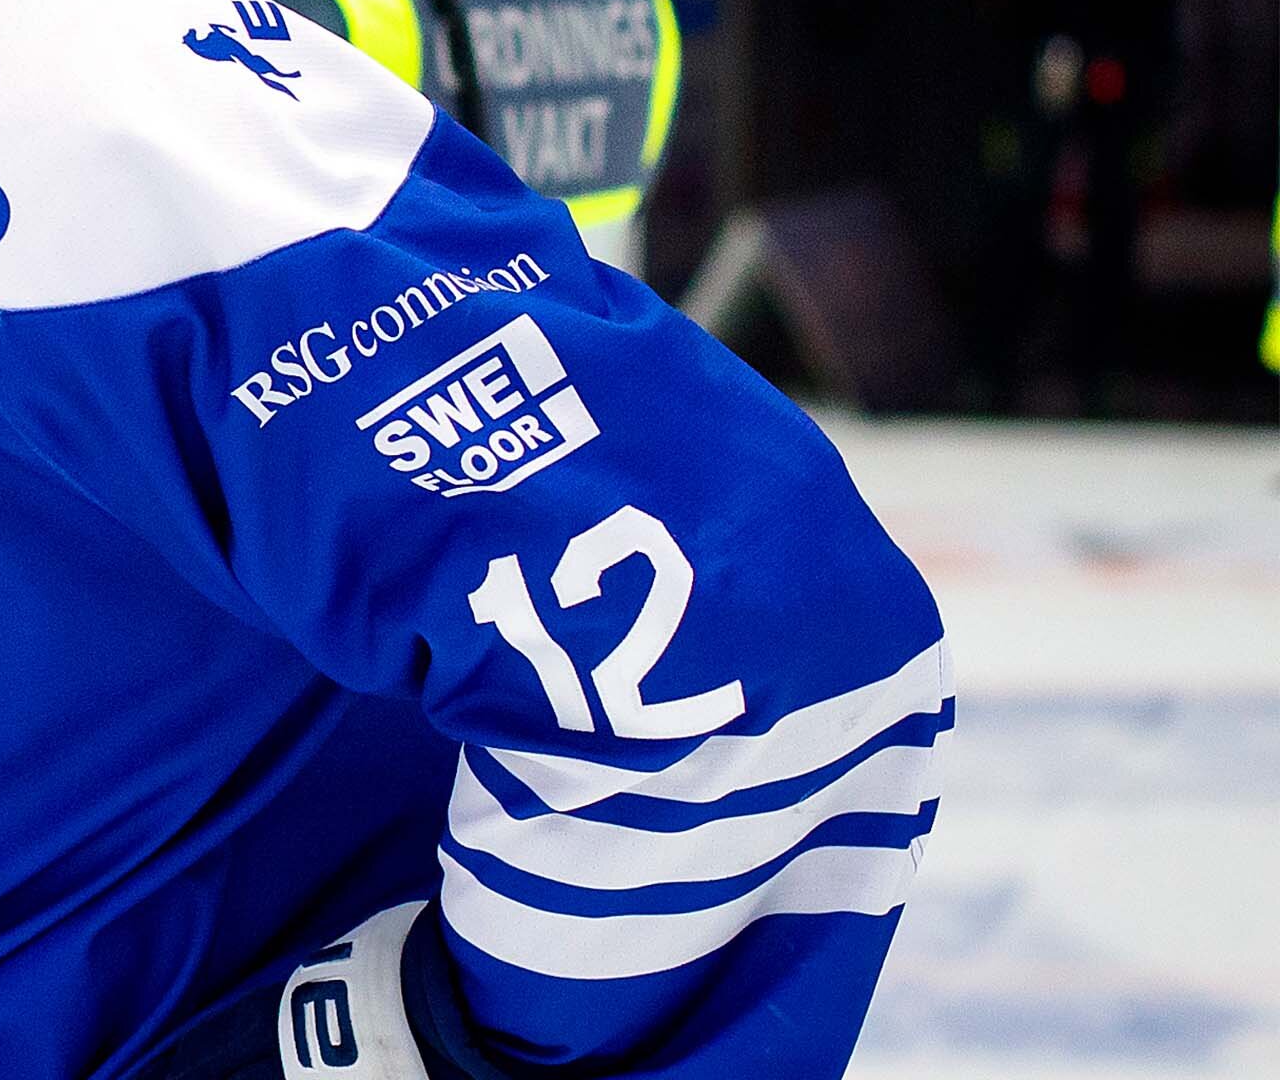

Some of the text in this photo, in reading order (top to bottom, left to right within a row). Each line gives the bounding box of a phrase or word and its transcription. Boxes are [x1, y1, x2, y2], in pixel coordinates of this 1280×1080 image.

[504, 96, 608, 180] VAKT
[230, 321, 353, 429] RSG
[373, 357, 526, 473] SWE
[411, 416, 553, 493] FLOOR
[467, 505, 746, 740] 12
